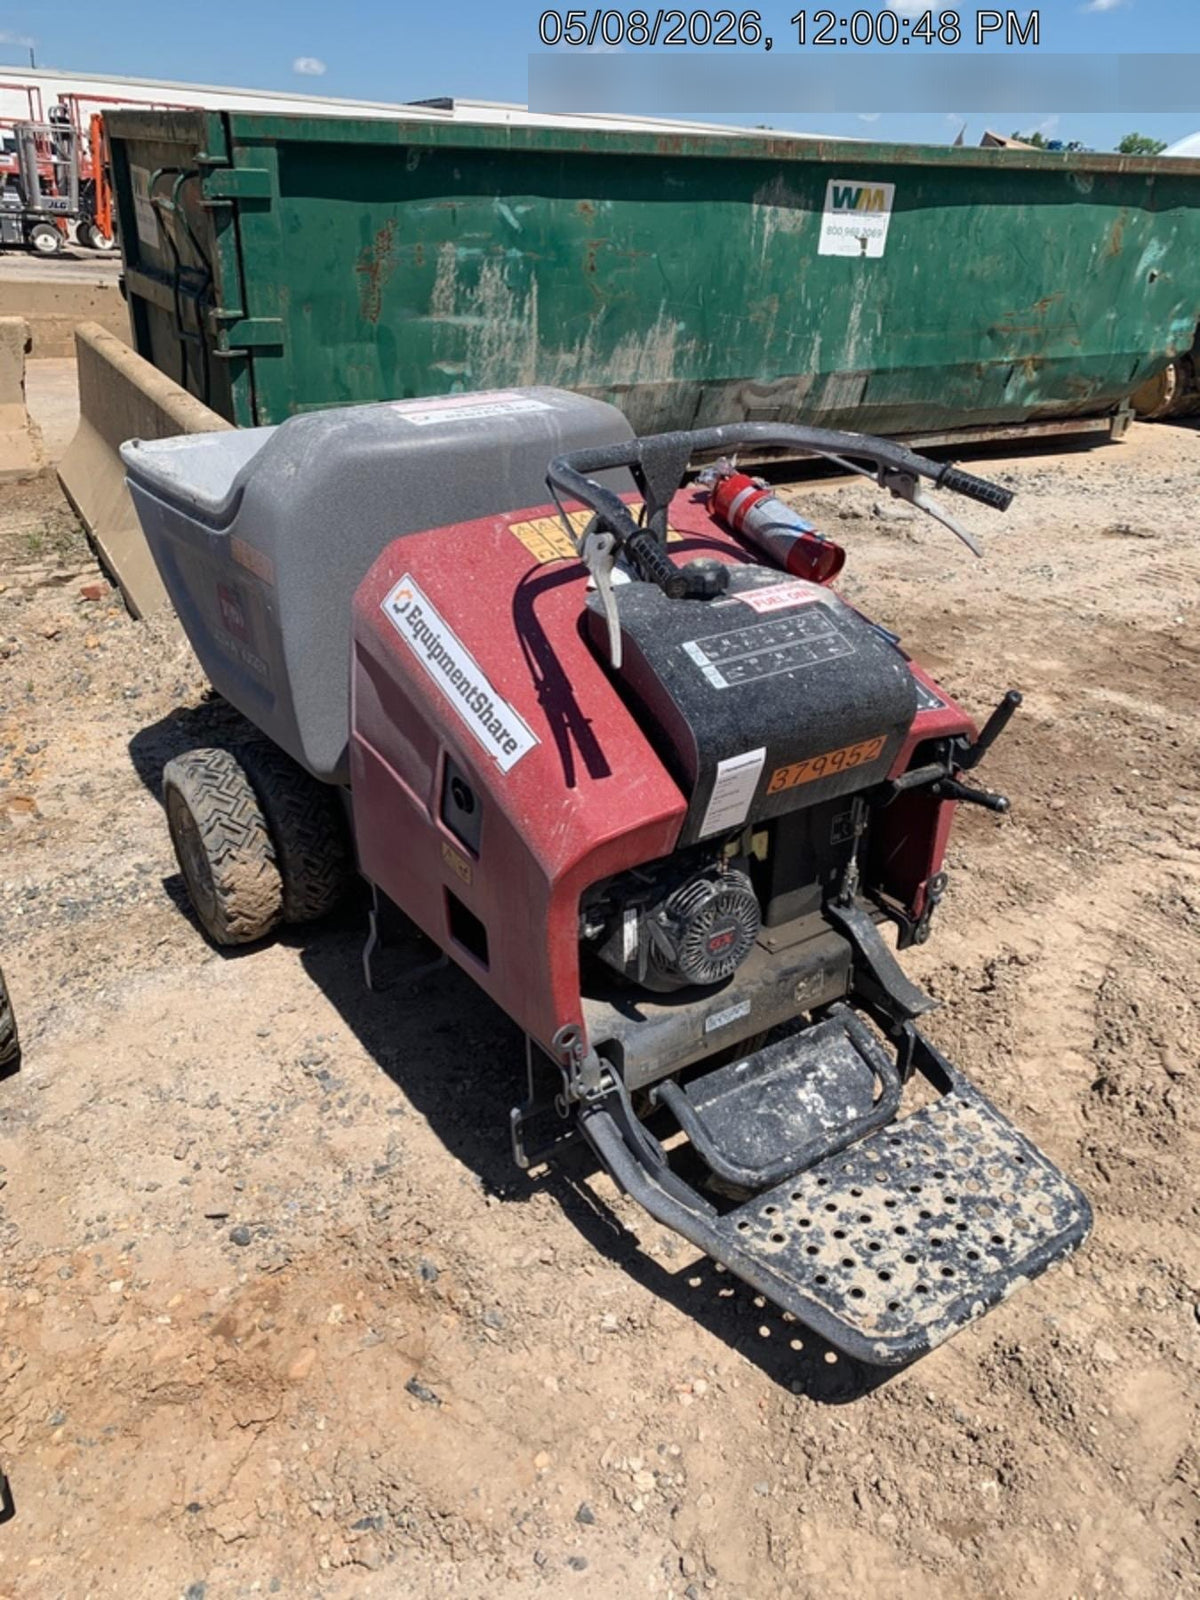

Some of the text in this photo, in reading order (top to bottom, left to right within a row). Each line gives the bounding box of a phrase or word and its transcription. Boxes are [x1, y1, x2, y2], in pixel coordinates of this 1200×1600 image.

[48, 201, 67, 209] JLG
[832, 186, 885, 212] WM
[404, 605, 519, 756] EquipmentShare
[771, 739, 883, 791] 379952
